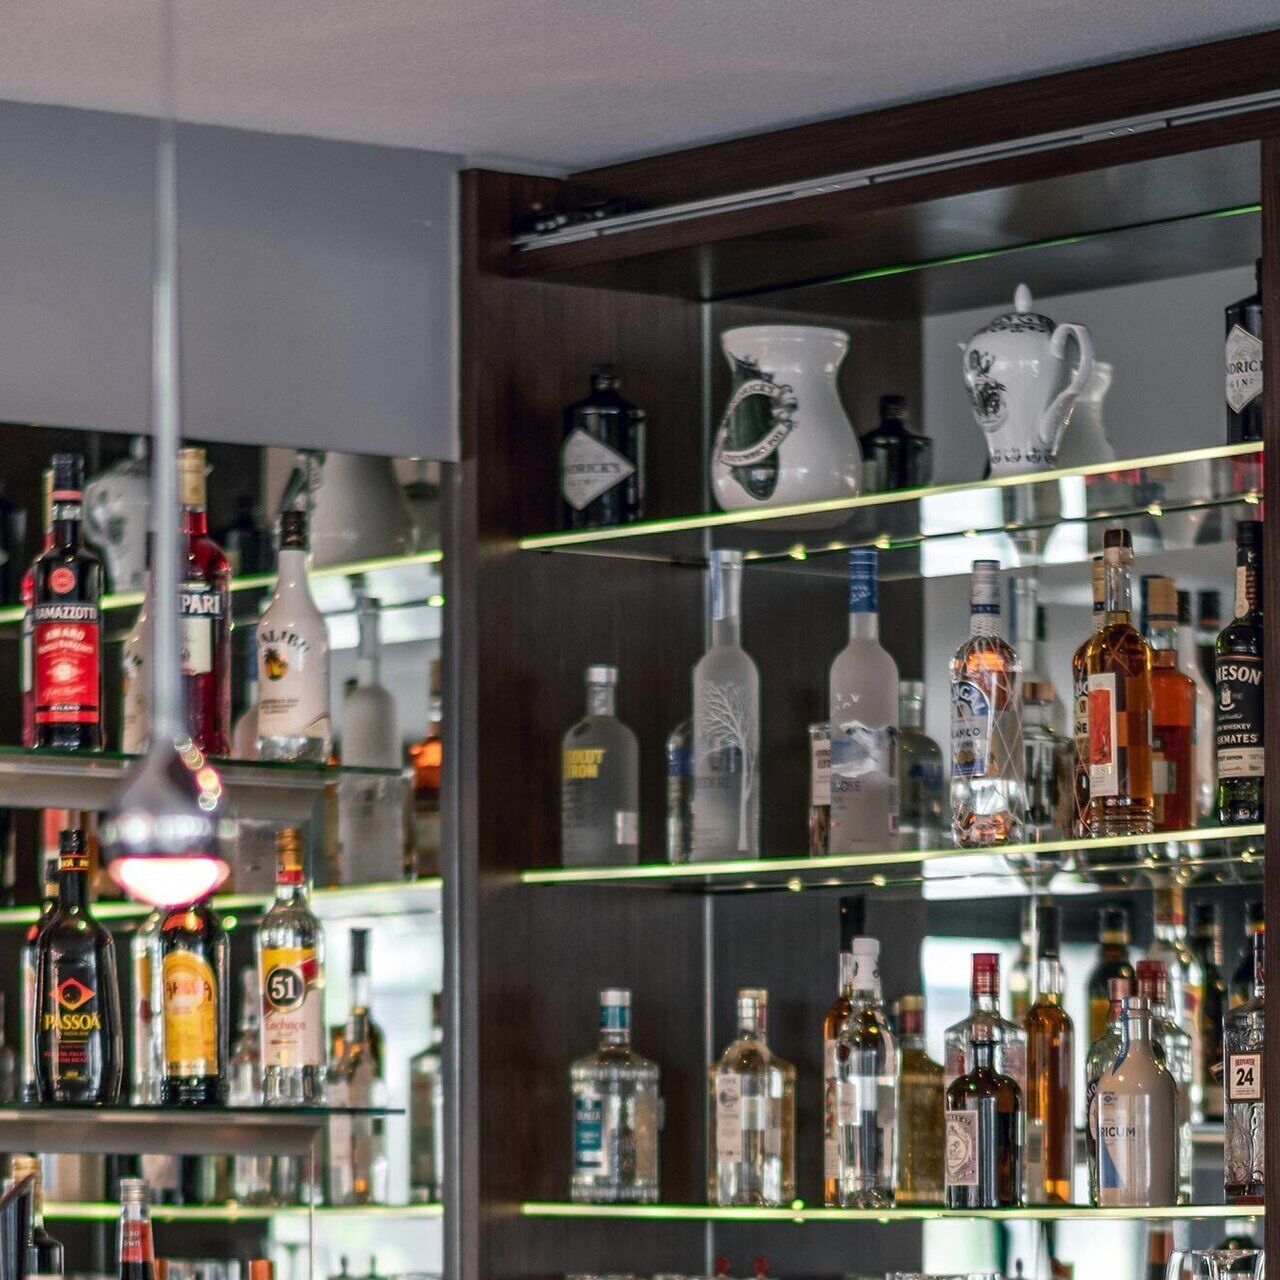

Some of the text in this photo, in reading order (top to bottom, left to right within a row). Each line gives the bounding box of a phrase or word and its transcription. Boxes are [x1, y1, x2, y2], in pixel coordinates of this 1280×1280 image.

[1224, 360, 1263, 374] DRIC
[181, 594, 221, 614] PARI
[272, 976, 297, 1000] 51
[1236, 1067, 1254, 1086] 24
